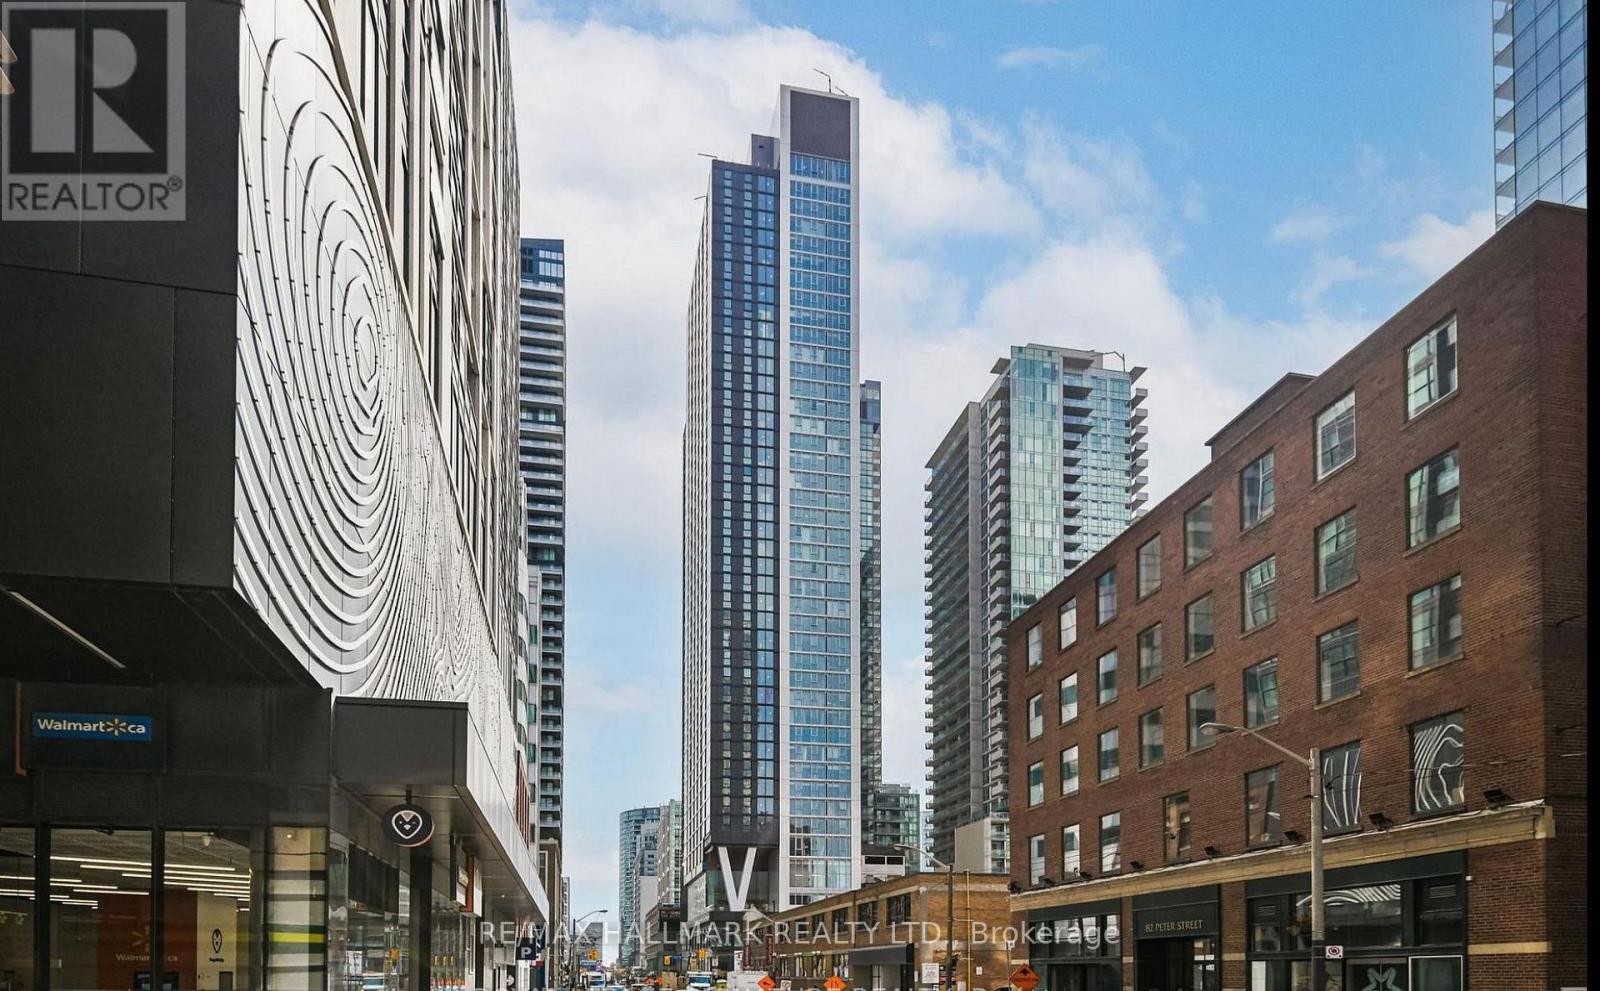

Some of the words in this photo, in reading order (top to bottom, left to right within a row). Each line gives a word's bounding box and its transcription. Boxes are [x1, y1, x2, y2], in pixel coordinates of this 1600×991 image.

[1156, 921, 1177, 932] PETER
[1178, 919, 1202, 930] STREET
[115, 953, 151, 962] Walmar
[520, 946, 533, 959] P
